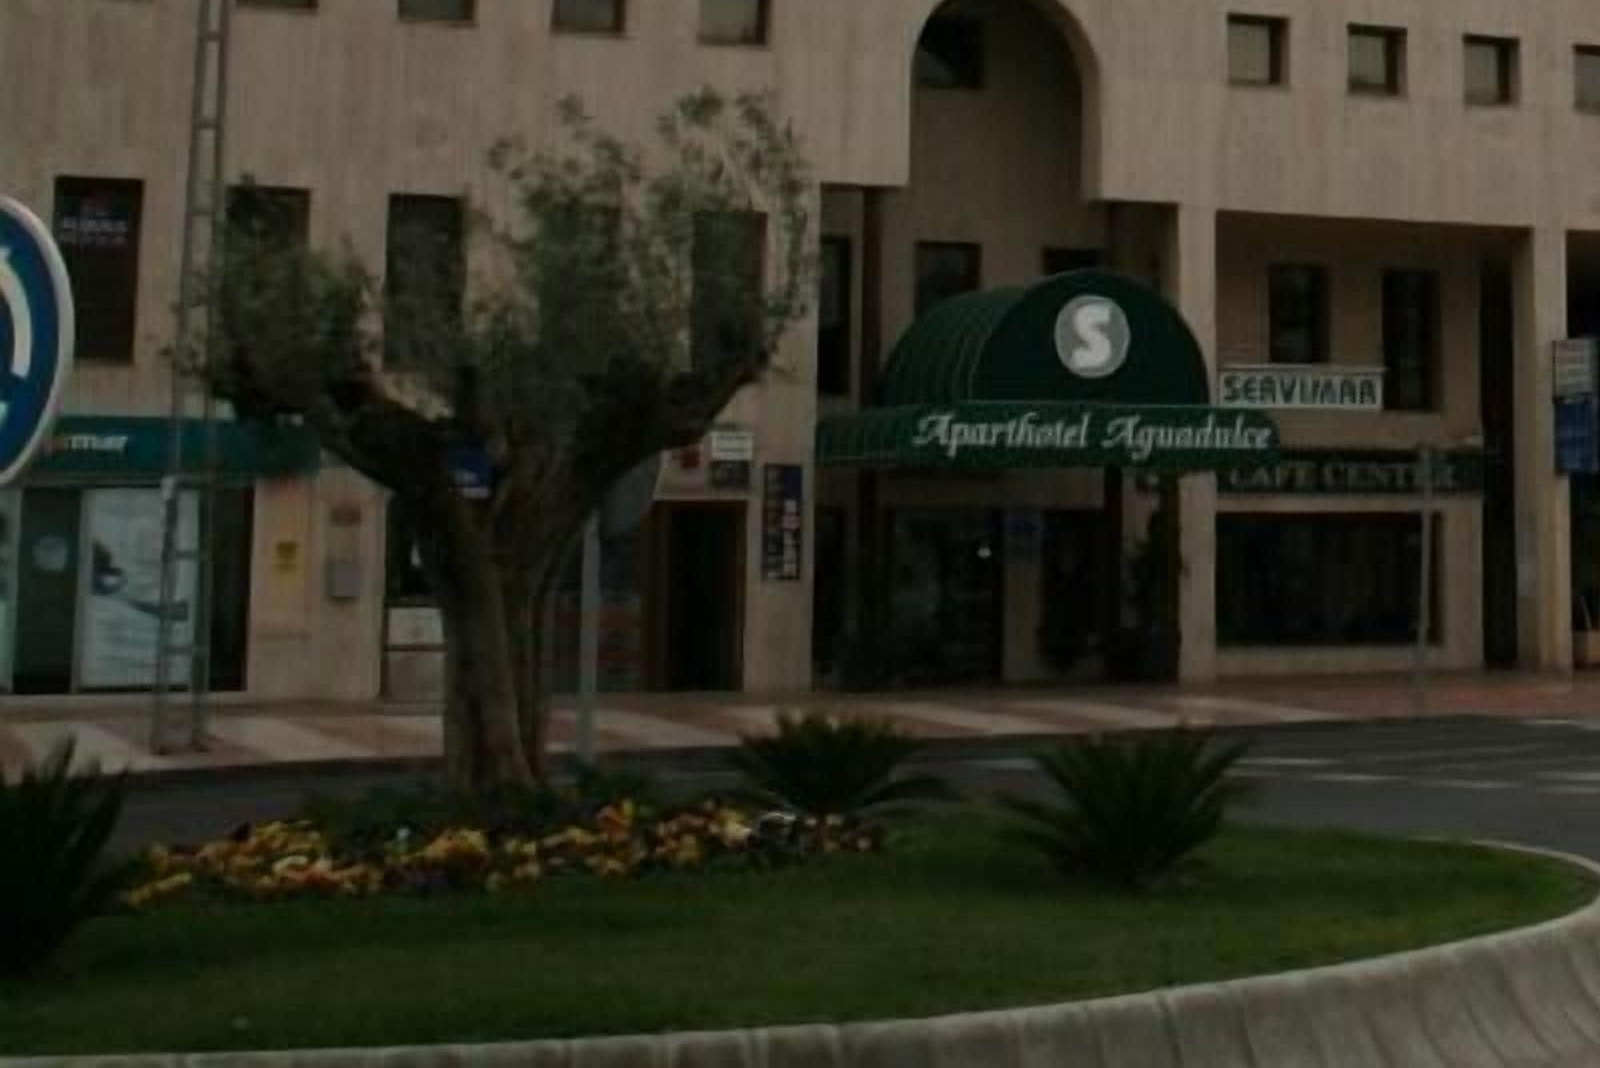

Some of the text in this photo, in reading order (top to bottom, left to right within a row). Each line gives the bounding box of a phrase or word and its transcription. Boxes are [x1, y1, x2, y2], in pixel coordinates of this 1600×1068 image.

[1223, 373, 1377, 405] SERVIMAR
[912, 410, 1273, 462] Aparthotel Aguadulce
